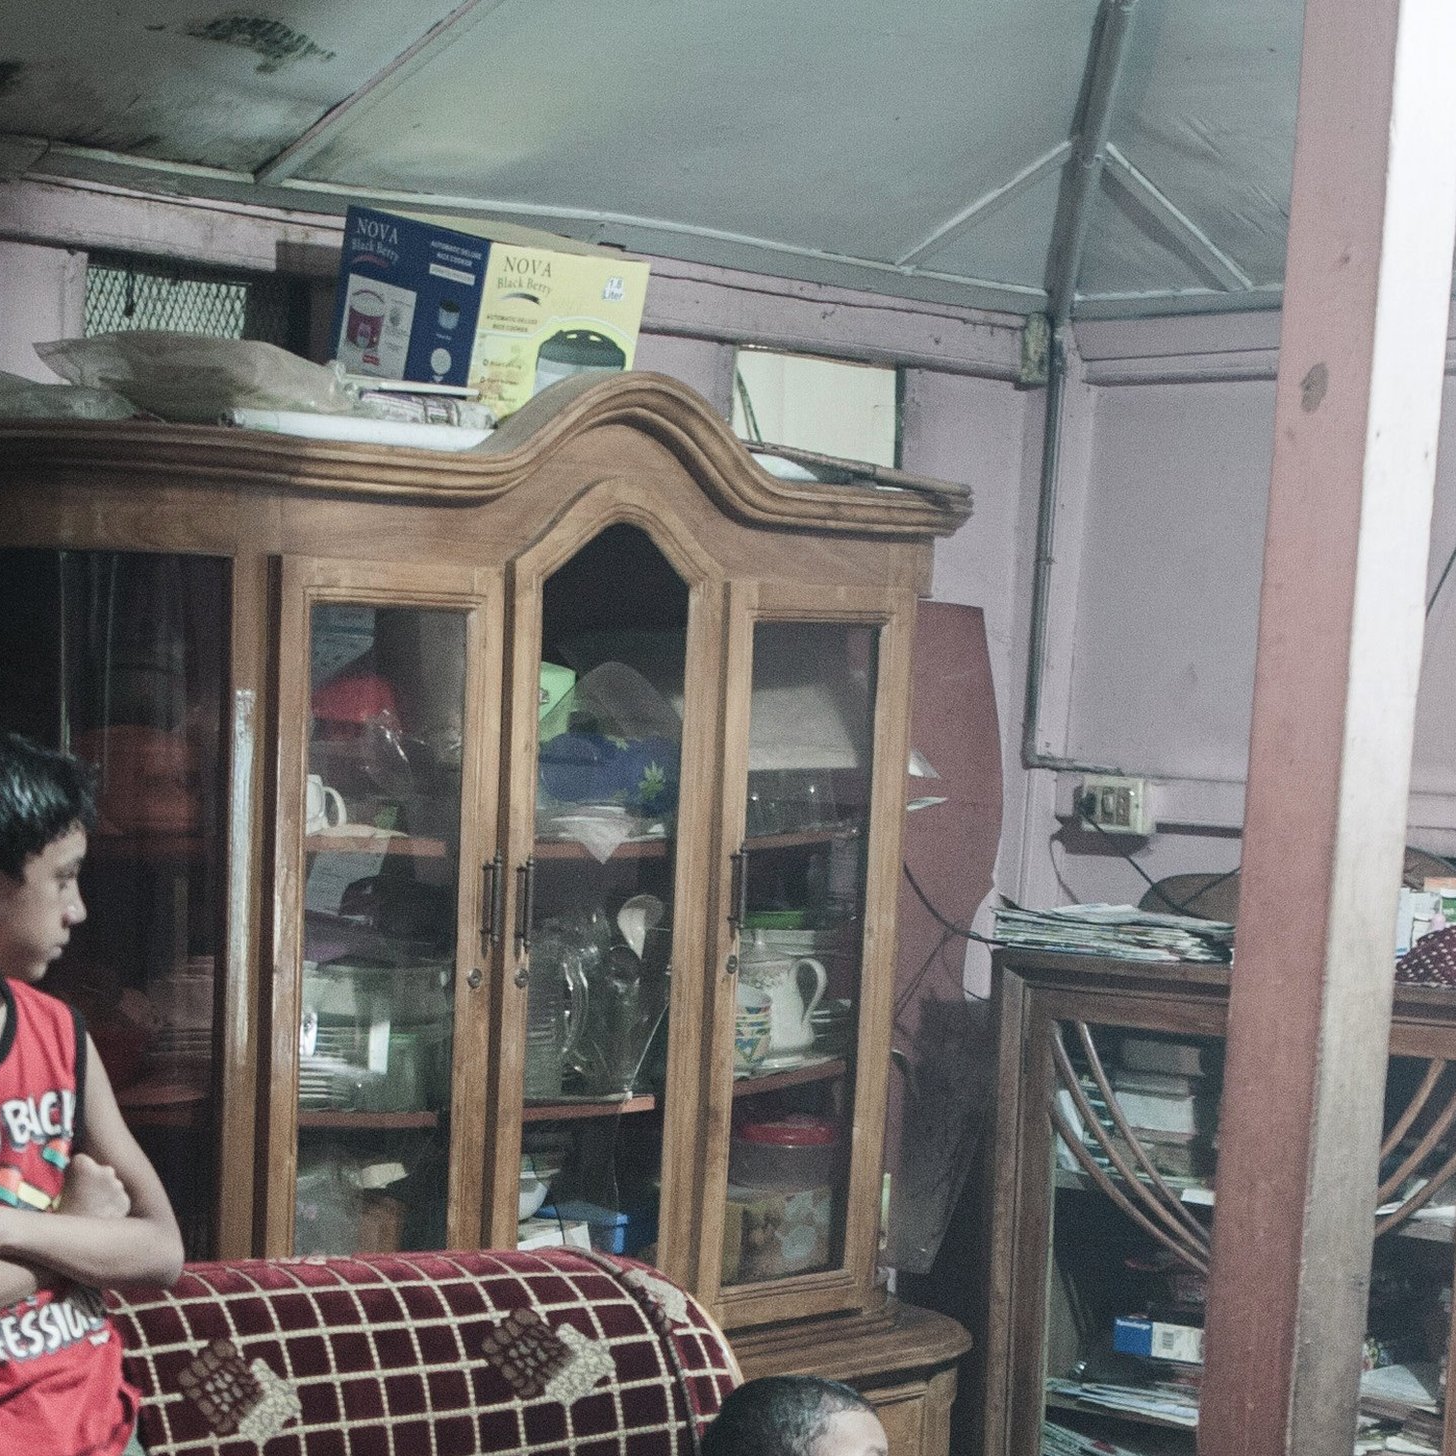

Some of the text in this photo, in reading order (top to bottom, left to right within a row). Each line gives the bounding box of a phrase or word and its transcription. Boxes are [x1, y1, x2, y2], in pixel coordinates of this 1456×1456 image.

[356, 216, 398, 245] NOVA
[504, 256, 552, 278] NOVA
[497, 276, 553, 296] Black Berry
